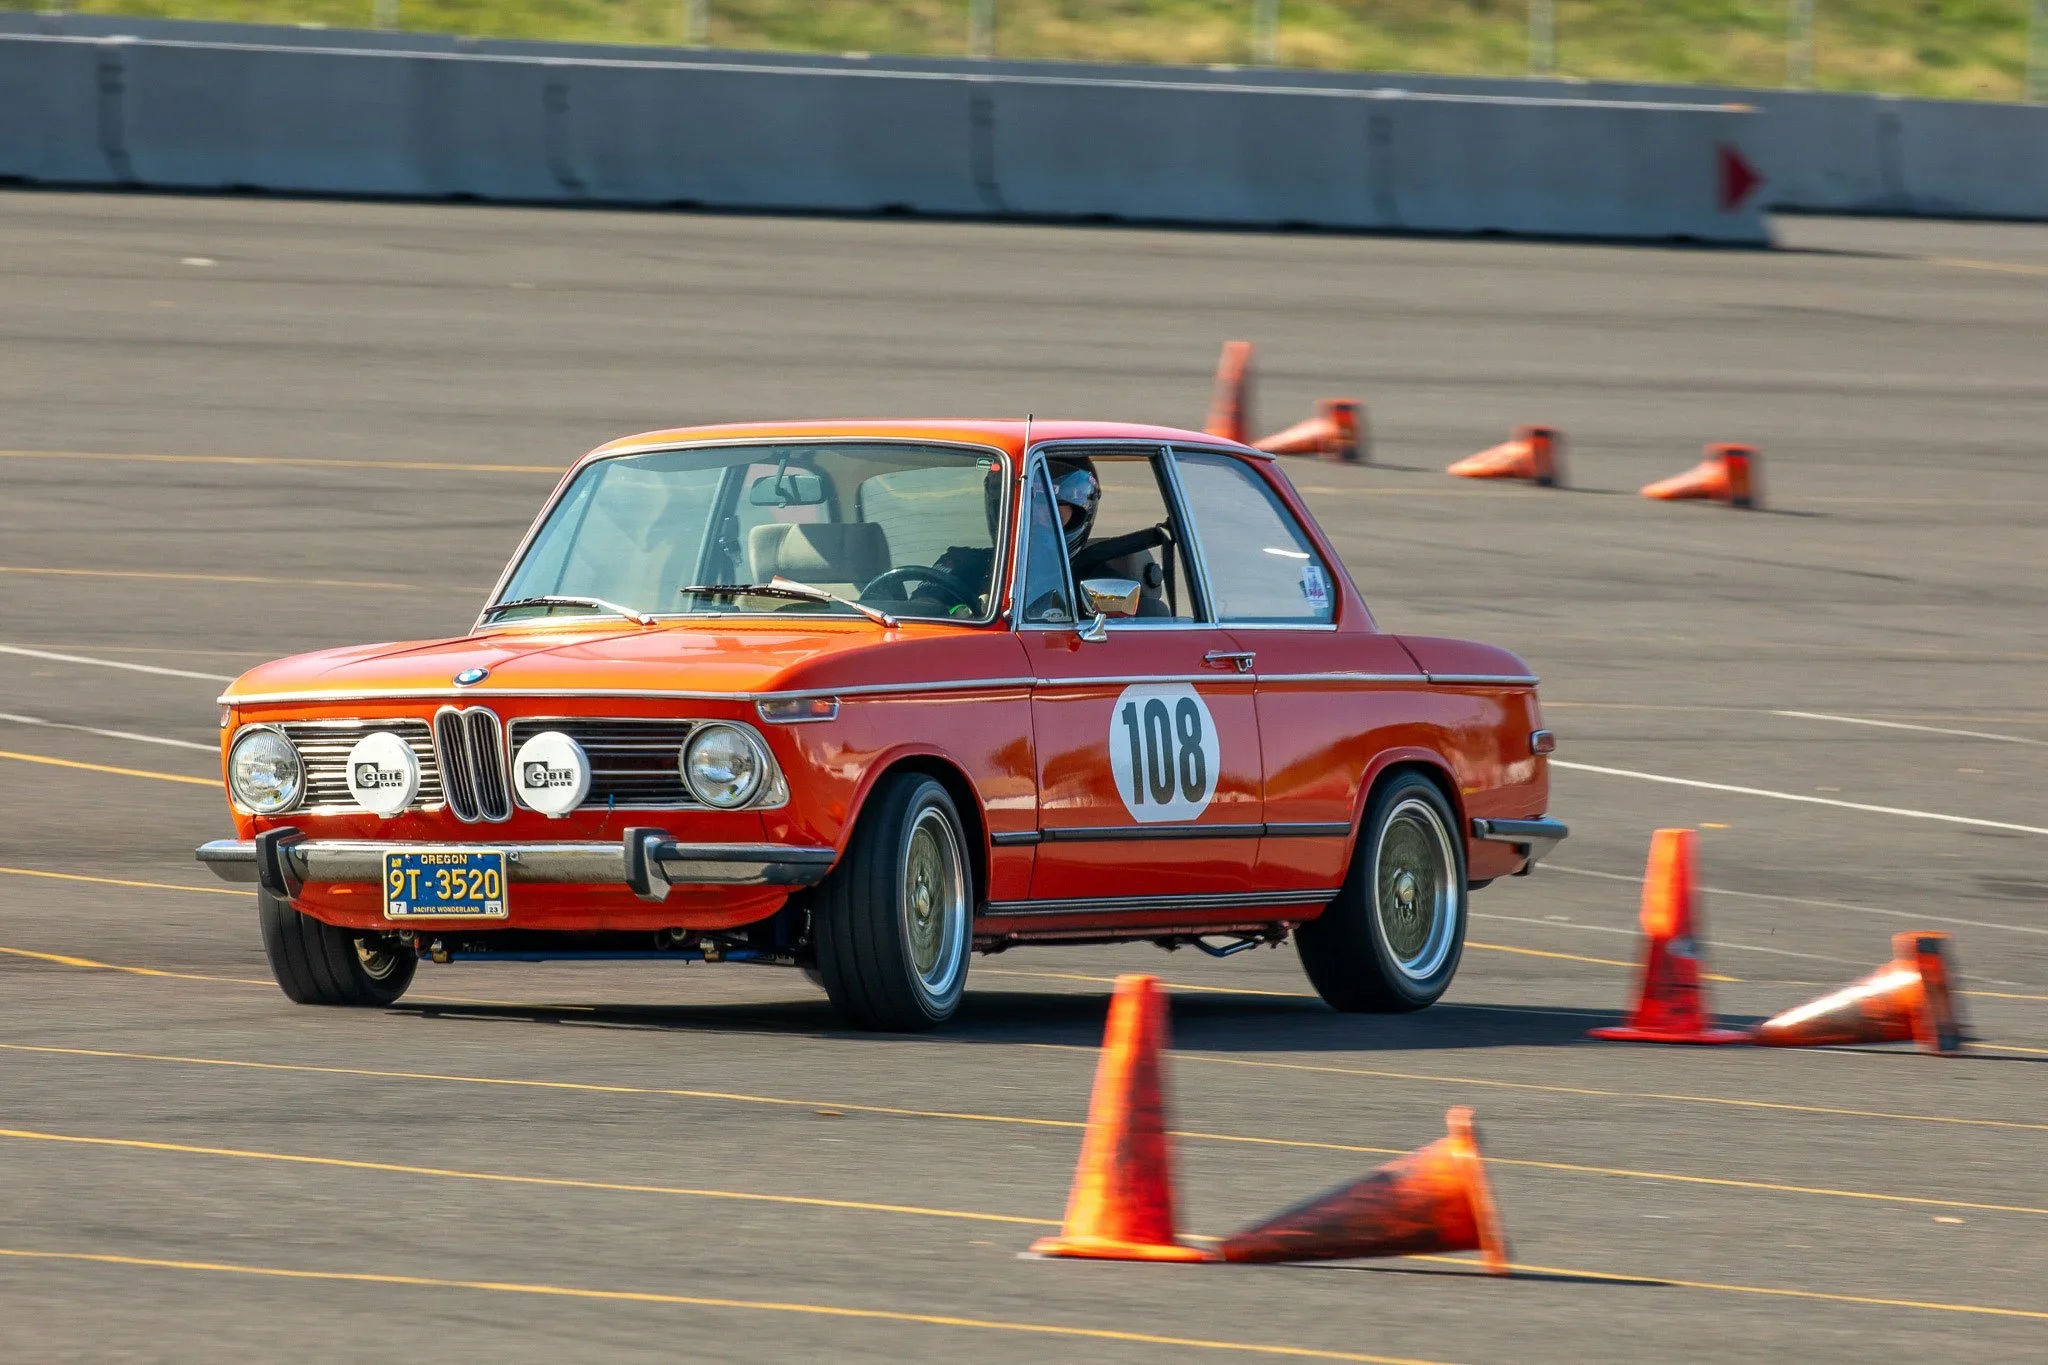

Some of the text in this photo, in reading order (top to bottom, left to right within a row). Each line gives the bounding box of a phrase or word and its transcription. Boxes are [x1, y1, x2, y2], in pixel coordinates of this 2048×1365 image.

[1122, 697, 1206, 804] 108
[420, 854, 468, 865] OREGON
[389, 868, 500, 900] 9T-3520
[395, 903, 402, 913] 7
